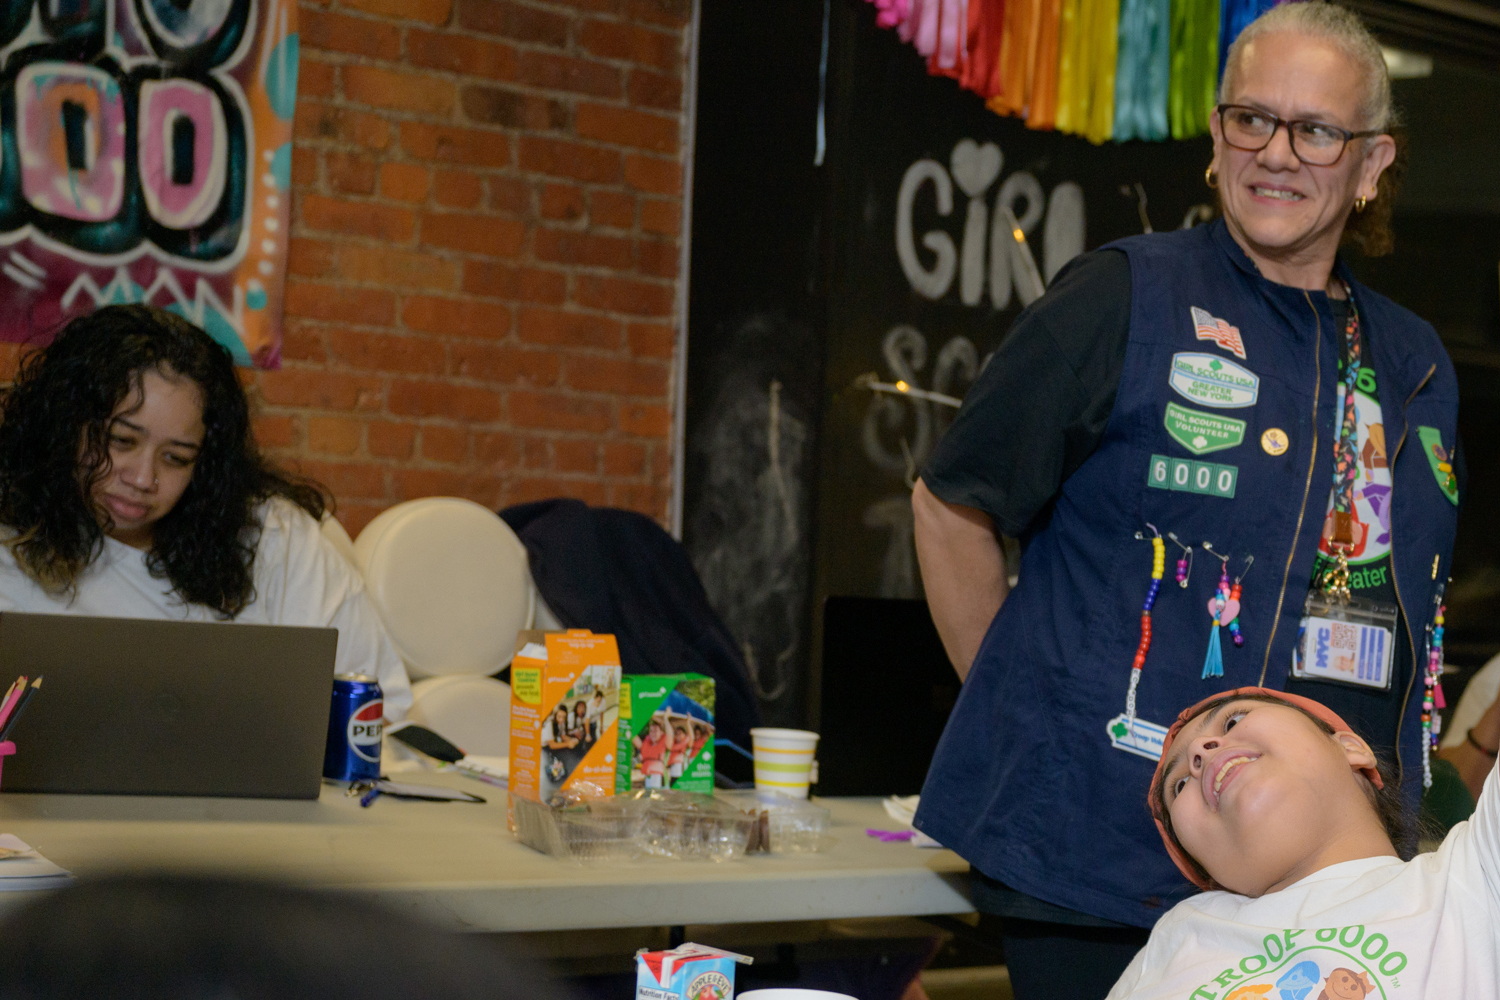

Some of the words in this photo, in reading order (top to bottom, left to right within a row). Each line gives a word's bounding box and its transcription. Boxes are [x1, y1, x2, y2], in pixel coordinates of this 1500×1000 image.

[1176, 360, 1195, 373] GIRL
[1197, 367, 1235, 384] SCOUTS
[1236, 377, 1255, 388] USA
[1187, 386, 1209, 397] NEW
[1209, 391, 1235, 403] YORK
[1191, 380, 1232, 396] GREATER
[1169, 409, 1188, 422] GIRL
[1188, 415, 1222, 430] SCOUTS
[1223, 422, 1241, 433] USA
[1174, 420, 1229, 439] VOLUNTEER
[1153, 460, 1233, 492] 6000
[1315, 626, 1331, 669] NYC
